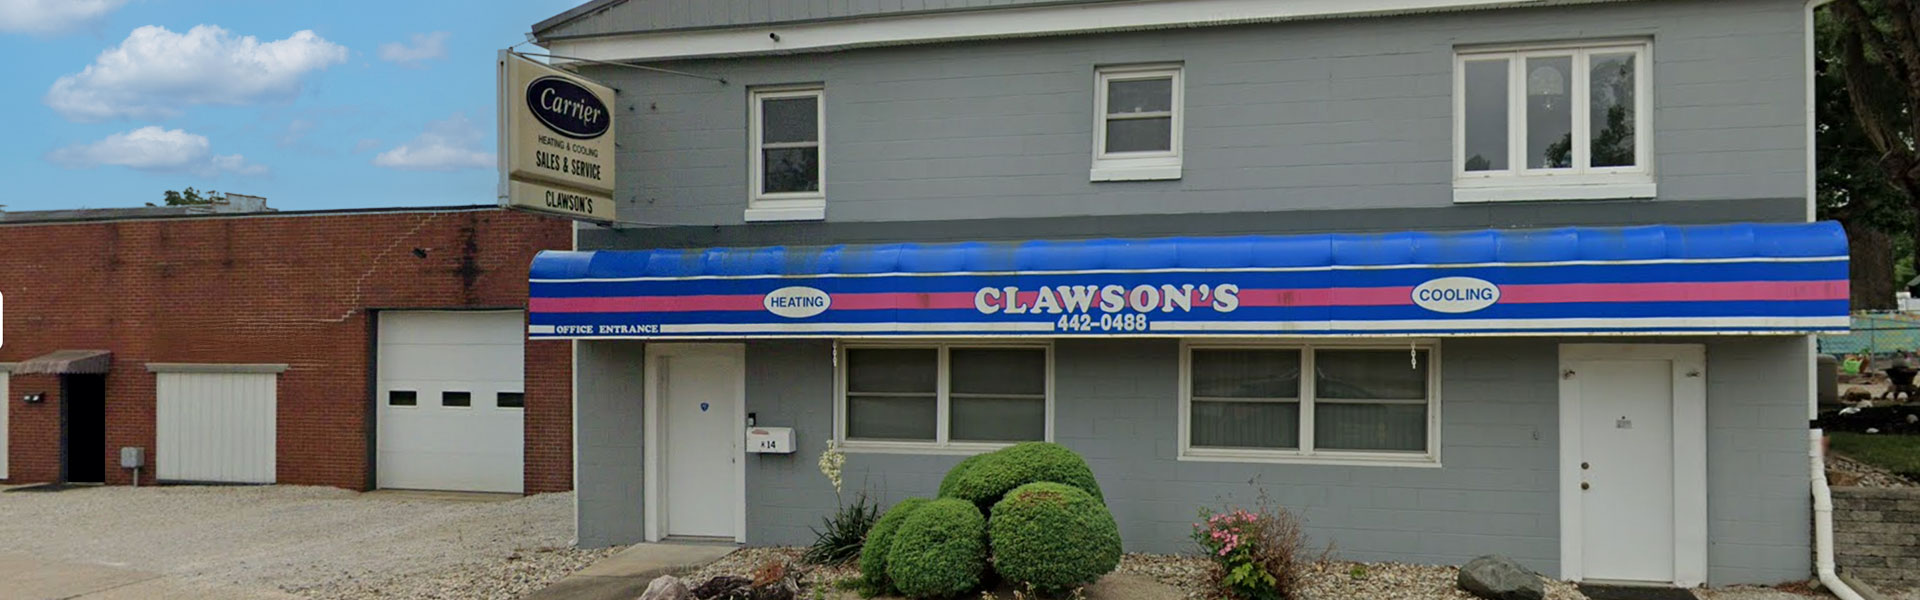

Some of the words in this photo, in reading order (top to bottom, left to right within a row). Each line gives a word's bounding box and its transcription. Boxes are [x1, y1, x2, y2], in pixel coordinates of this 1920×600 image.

[541, 87, 601, 123] Carrier
[538, 135, 565, 150] HEATING
[572, 143, 598, 158] COOLING
[536, 150, 560, 171] SALES
[562, 157, 569, 173] &
[571, 159, 601, 180] SERVICE
[545, 190, 593, 214] CLAWSON'S
[770, 296, 824, 307] HEATING
[974, 284, 1239, 315] CLAWSON'S
[1419, 287, 1494, 302] COOLING
[556, 325, 594, 334] OFFICE
[599, 324, 659, 334] ENTRANCE
[1057, 313, 1148, 332] 442-0488
